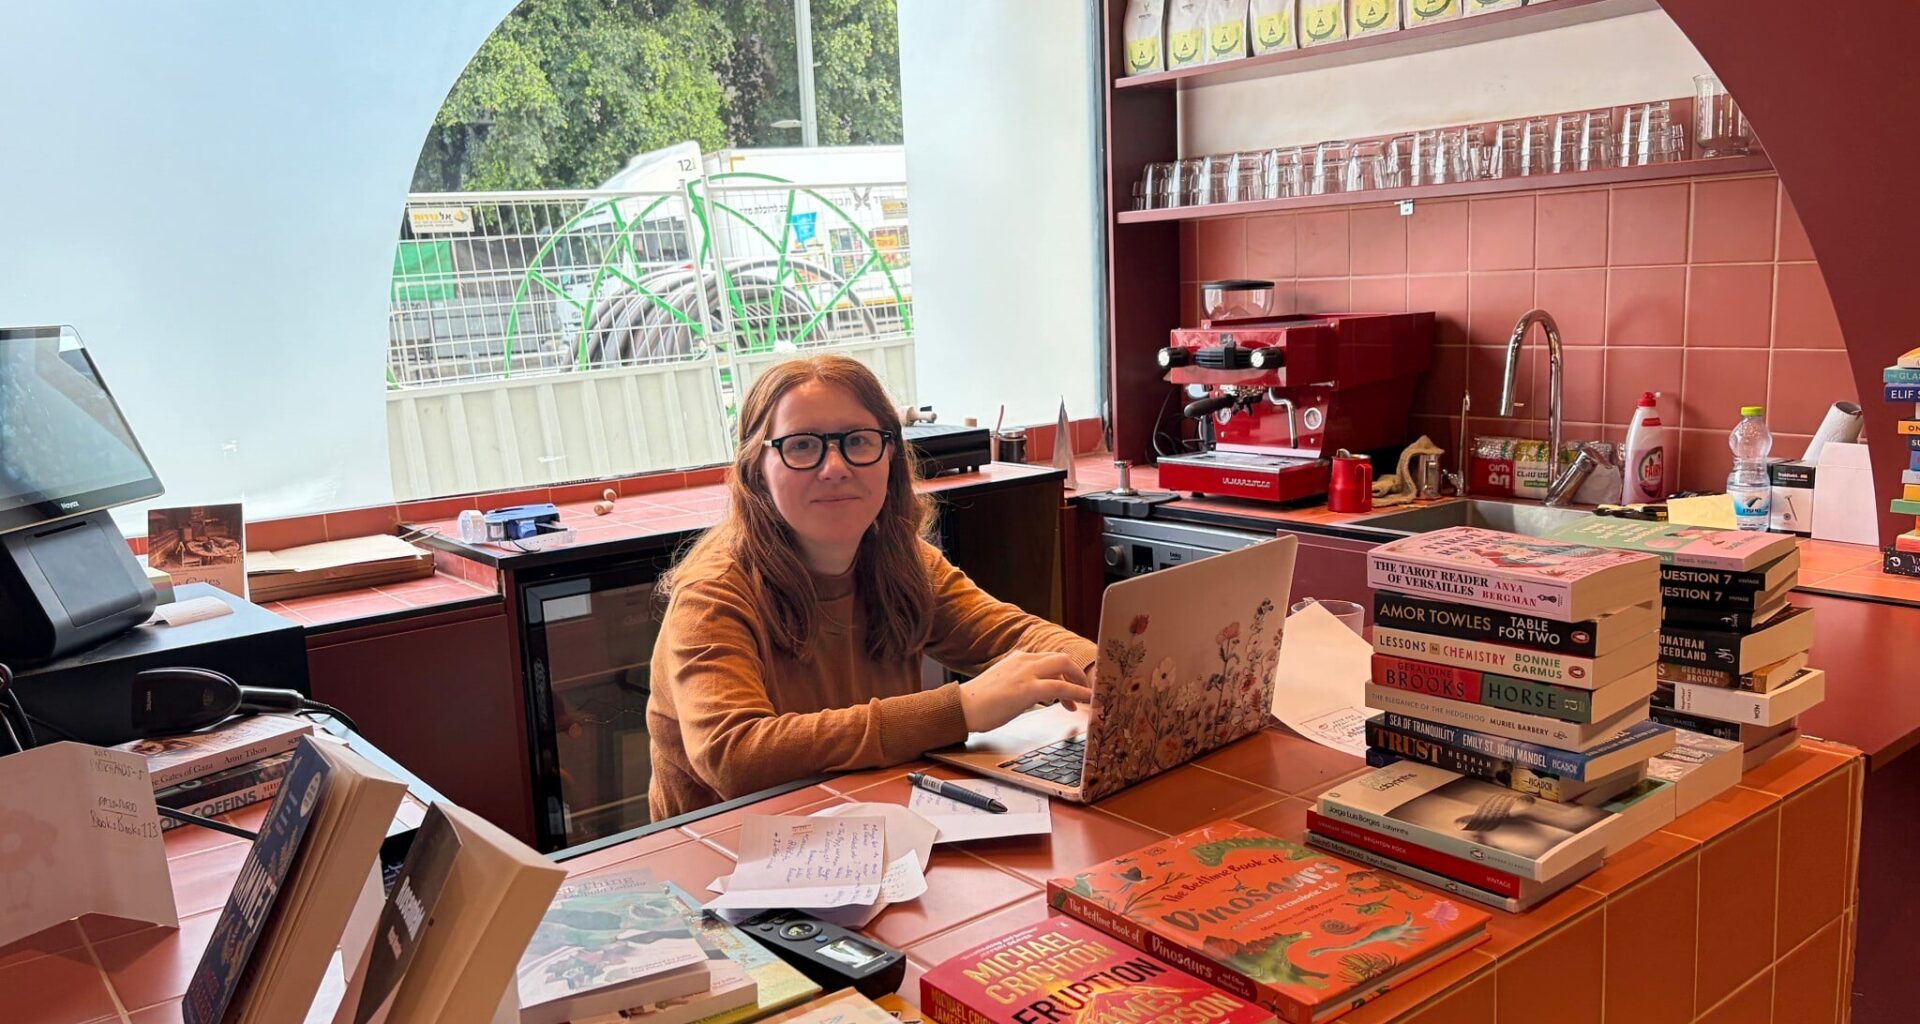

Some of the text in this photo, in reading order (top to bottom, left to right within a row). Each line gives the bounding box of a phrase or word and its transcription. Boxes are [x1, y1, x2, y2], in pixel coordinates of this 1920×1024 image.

[1891, 390, 1914, 399] ELIF
[1374, 560, 1489, 588] THE TAROT READER
[1660, 570, 1720, 584] UESTION
[1724, 575, 1732, 585] 7
[1387, 572, 1474, 597] OF VERSAILLES
[1494, 582, 1524, 593] ANYA
[1482, 590, 1537, 607] BERGMAN
[1714, 592, 1722, 602] 7
[1380, 604, 1492, 632] AMOR TOWLES
[1510, 616, 1548, 632] TABLE
[1498, 626, 1560, 645] FOR TWO
[1660, 634, 1704, 650] ONATHAN
[1380, 634, 1426, 652] LESSONS
[1444, 645, 1506, 666] CHEMISTRY
[1660, 646, 1707, 662] REEDLAND
[1398, 662, 1452, 678] GERALDINE
[1515, 653, 1561, 668] BONNIE
[1513, 664, 1562, 680] GARMUS
[1681, 666, 1725, 678] GERALDINE
[1686, 673, 1718, 684] BROOKS
[1386, 668, 1465, 698] BROOKS
[1489, 682, 1558, 710] HORSE
[1432, 704, 1444, 714] THE
[1446, 708, 1484, 722] HEDGEHOG
[1490, 718, 1515, 730] MURIEL
[1518, 723, 1549, 736] BARBERY
[1373, 726, 1443, 764] TRUST
[1390, 714, 1578, 774] SEA OF TRANQUILITY EMILY ST. JOHN MANDEL PICADOR
[160, 774, 183, 784] Gates
[184, 768, 192, 776] of
[194, 762, 214, 774] Gaza
[224, 754, 242, 764] Amir
[245, 746, 268, 758] Tibon
[1448, 750, 1552, 792] HERMAN PICADOR
[1456, 764, 1484, 776] DIAZ
[192, 790, 257, 819] COFFINS
[1328, 806, 1346, 817] Jorge
[1346, 811, 1358, 820] Luis
[1358, 814, 1380, 828] Borges
[1364, 836, 1390, 849] BRIGHTON
[1392, 844, 1406, 854] ROCK
[1268, 854, 1285, 864] of
[1486, 876, 1511, 889] VINTAGE
[1161, 862, 1341, 932] Dinosaurs
[1069, 898, 1213, 979] The Bedtime Book of Dinosaurs
[962, 931, 1084, 986] MICHAEL
[985, 940, 1118, 1006] CRICHTON
[1011, 957, 1168, 1024] ERUPTION
